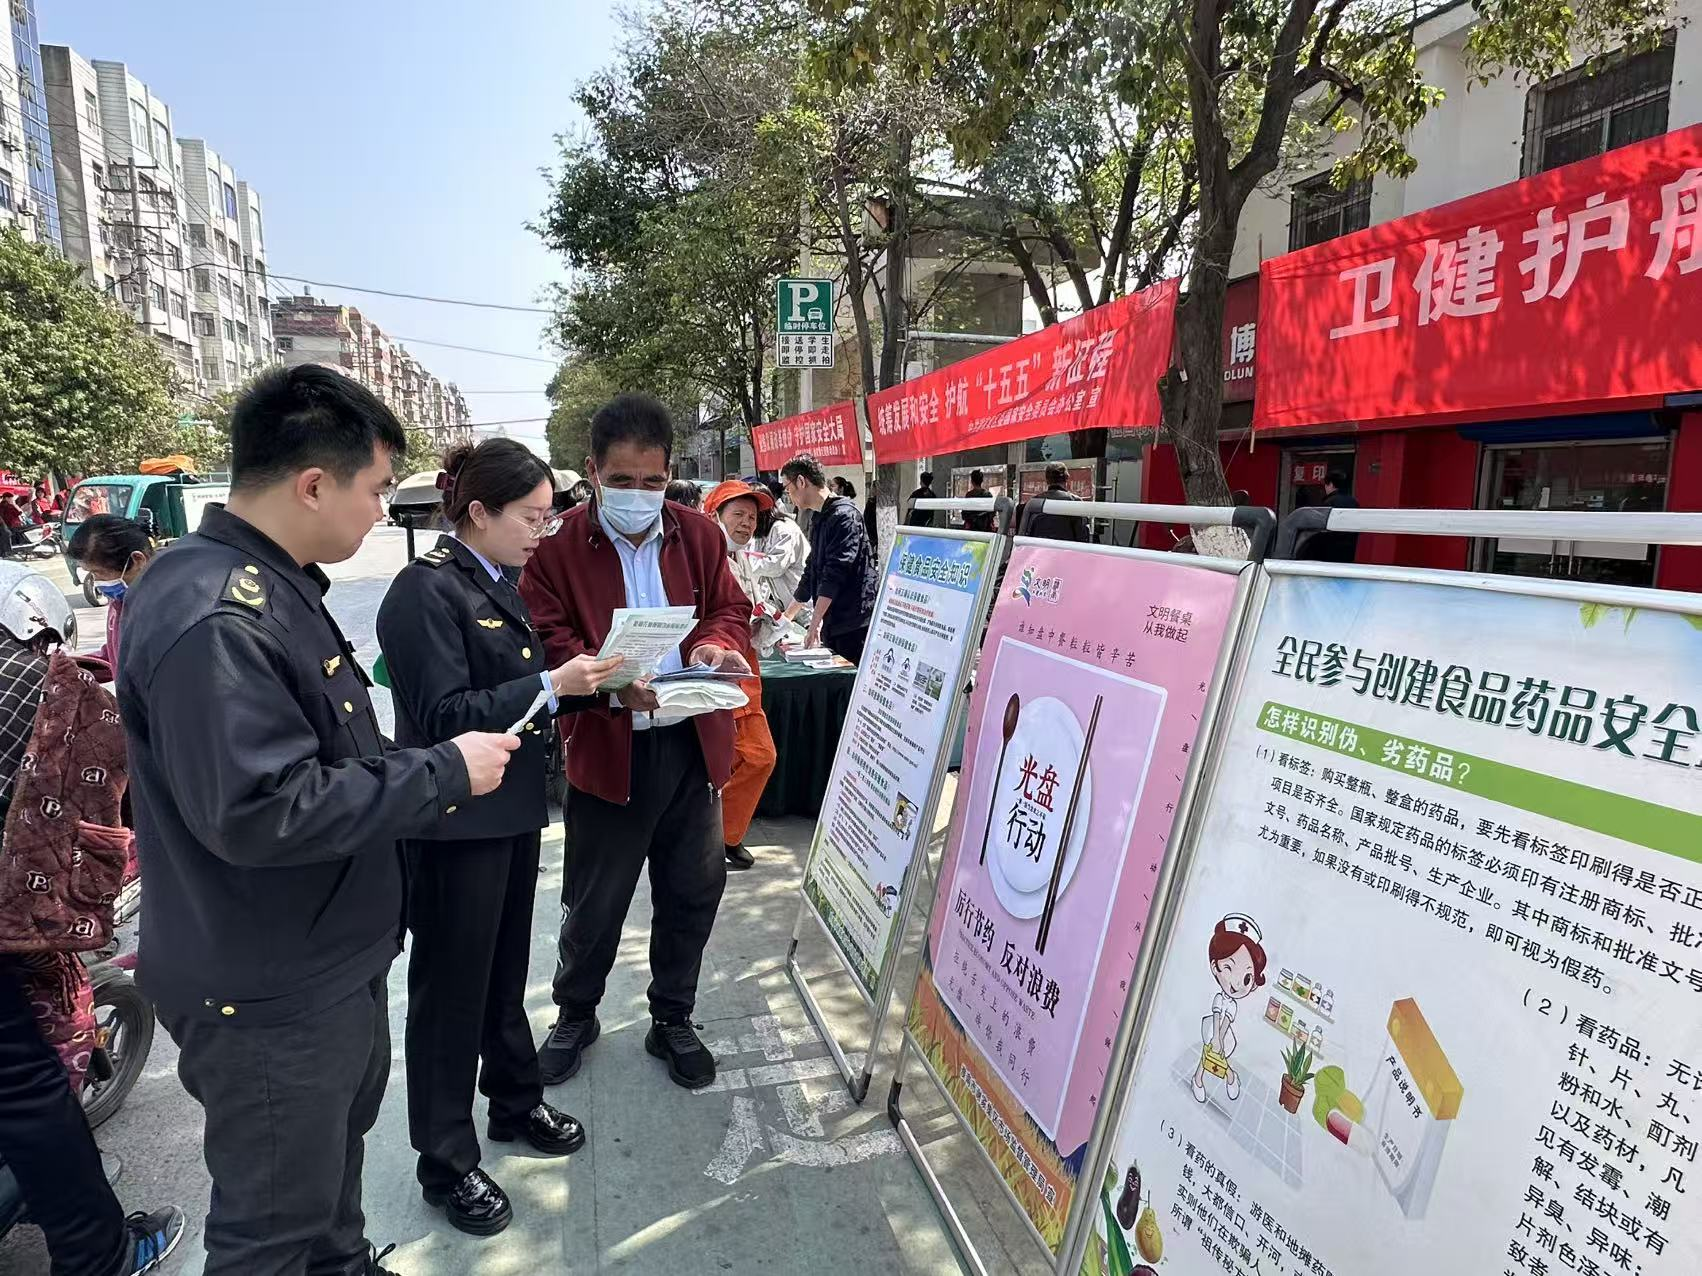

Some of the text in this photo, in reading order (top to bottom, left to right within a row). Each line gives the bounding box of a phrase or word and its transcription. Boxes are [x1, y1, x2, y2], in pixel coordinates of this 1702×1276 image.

[783, 322, 827, 330] 临时停车位
[787, 283, 819, 322] P
[781, 336, 830, 345] 接送学生
[781, 346, 830, 354] 即停即走
[781, 356, 830, 365] 监控抓拍
[1231, 323, 1256, 366] 博
[877, 389, 940, 436] 统筹发展和安全
[945, 376, 969, 420] 护航
[1045, 329, 1118, 392] 新征程
[1293, 465, 1327, 482] 复印
[1143, 620, 1189, 643] 从我做起
[1147, 605, 1193, 626] 文明餐桌
[1271, 635, 1702, 770] 全民参与创建食品药品安全
[1263, 705, 1471, 785] 怎样识别伪、劣药品？
[1013, 753, 1060, 813] 光盘
[1007, 802, 1047, 863] 行动
[1270, 777, 1702, 950] 项目是否齐全。国家规定药品的标签必须印有注册商标、批
[955, 888, 995, 953] 厉行节约
[1000, 941, 1060, 1019] 反对浪费
[1386, 1056, 1422, 1118] 产品说明书
[1182, 1164, 1305, 1276] 钱，大都信口、开河，
[1516, 1213, 1618, 1276] 片剂色泽
